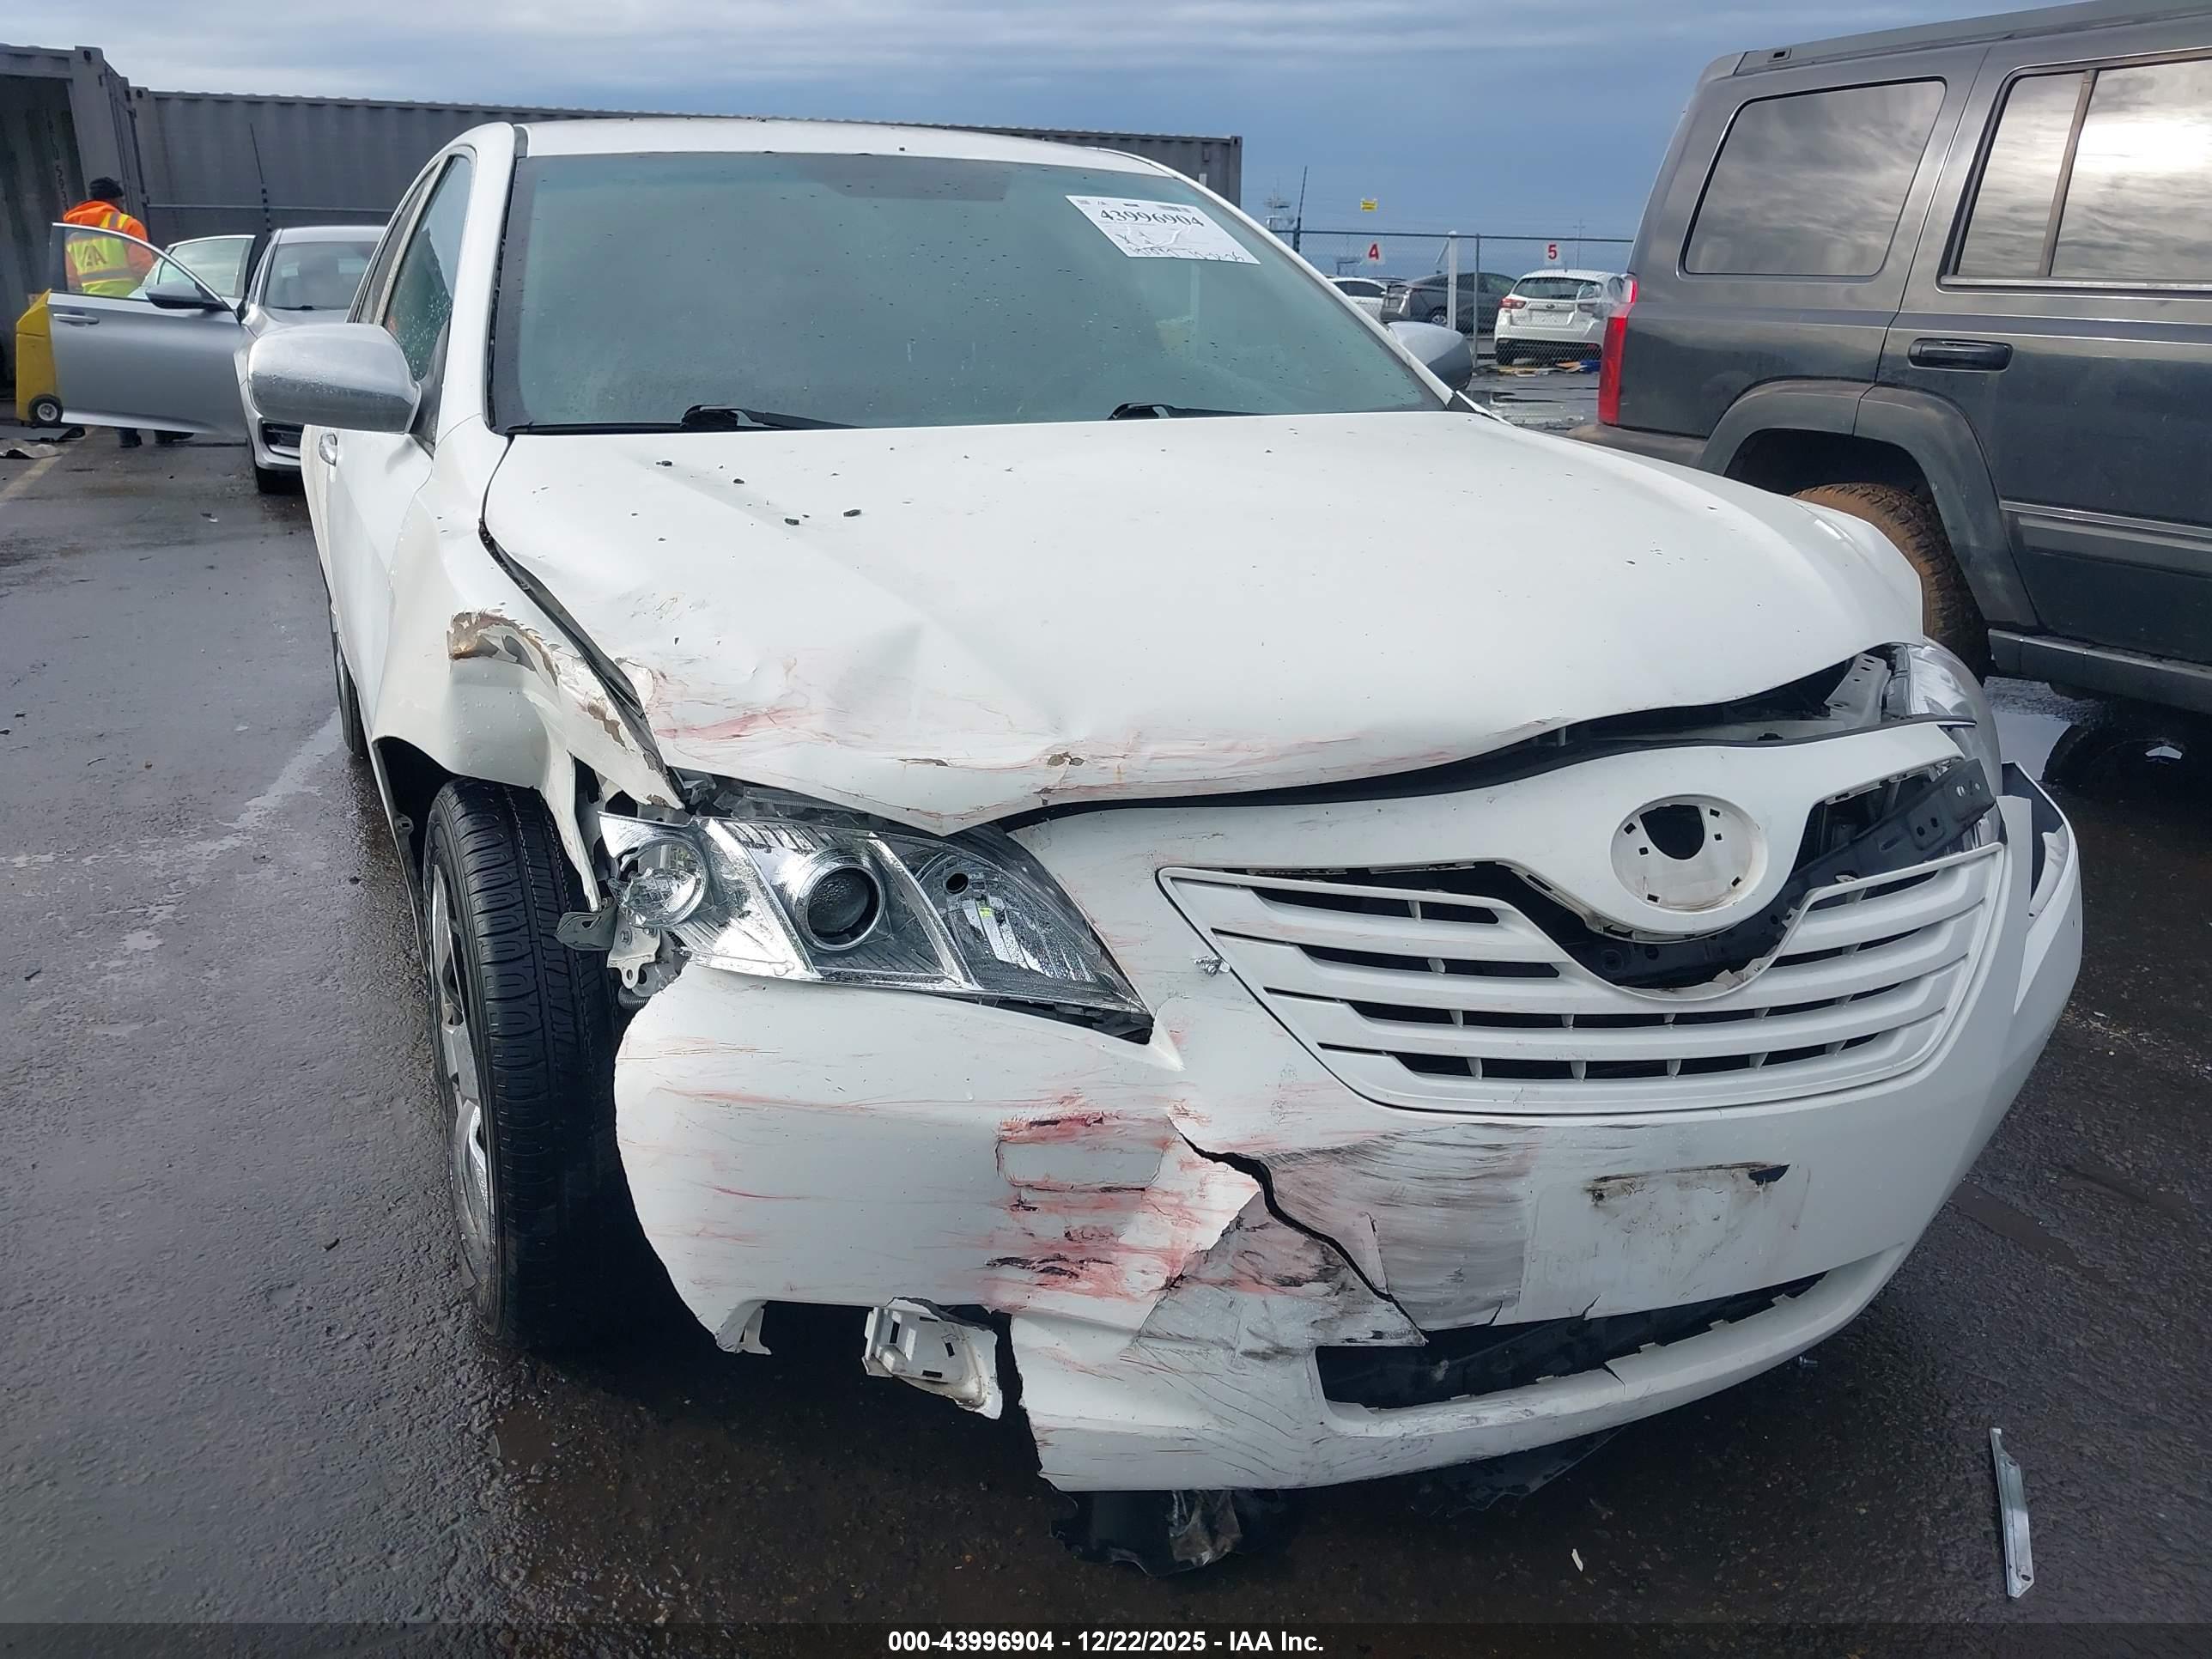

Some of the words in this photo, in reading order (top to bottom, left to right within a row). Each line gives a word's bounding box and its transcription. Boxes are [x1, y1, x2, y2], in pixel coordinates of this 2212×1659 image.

[1100, 209, 1206, 228] 43996904
[1368, 243, 1380, 260] 4
[1548, 244, 1559, 260] 5
